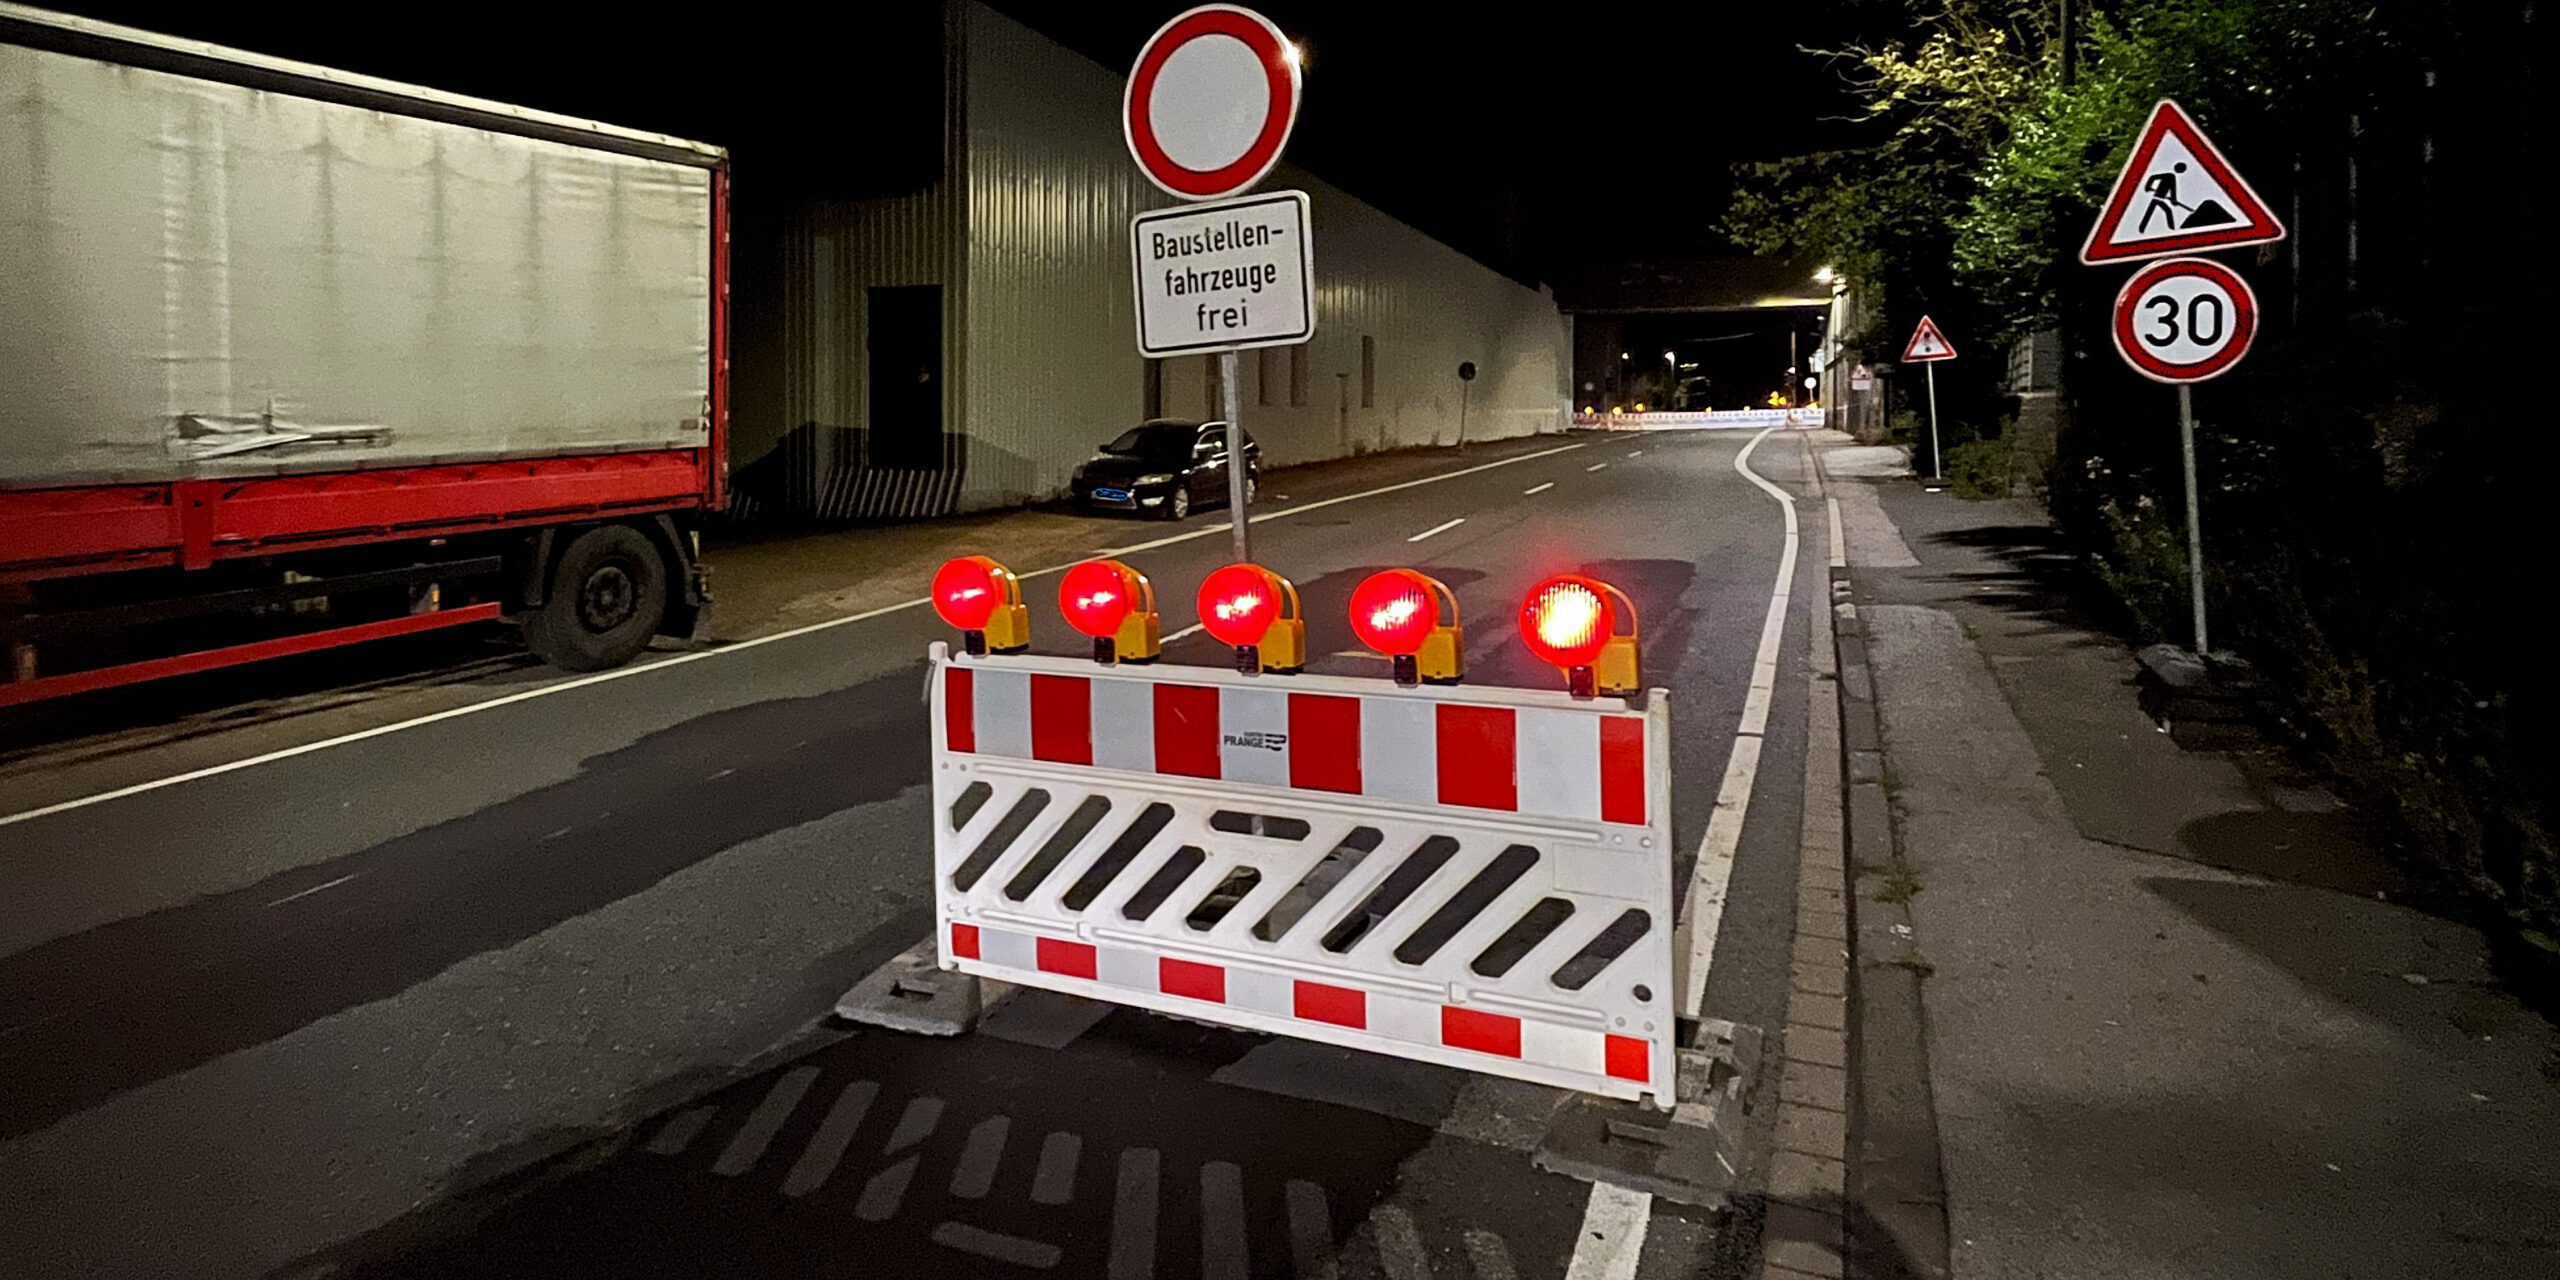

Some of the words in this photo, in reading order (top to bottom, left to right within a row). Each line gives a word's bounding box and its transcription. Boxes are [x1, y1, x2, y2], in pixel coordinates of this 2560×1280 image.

[1152, 220, 1284, 260] Baustellen-
[1165, 263, 1277, 297] fahrzeuge
[1197, 298, 1248, 332] frei
[2144, 293, 2223, 347] 30
[1223, 735, 1264, 749] PRANGE
